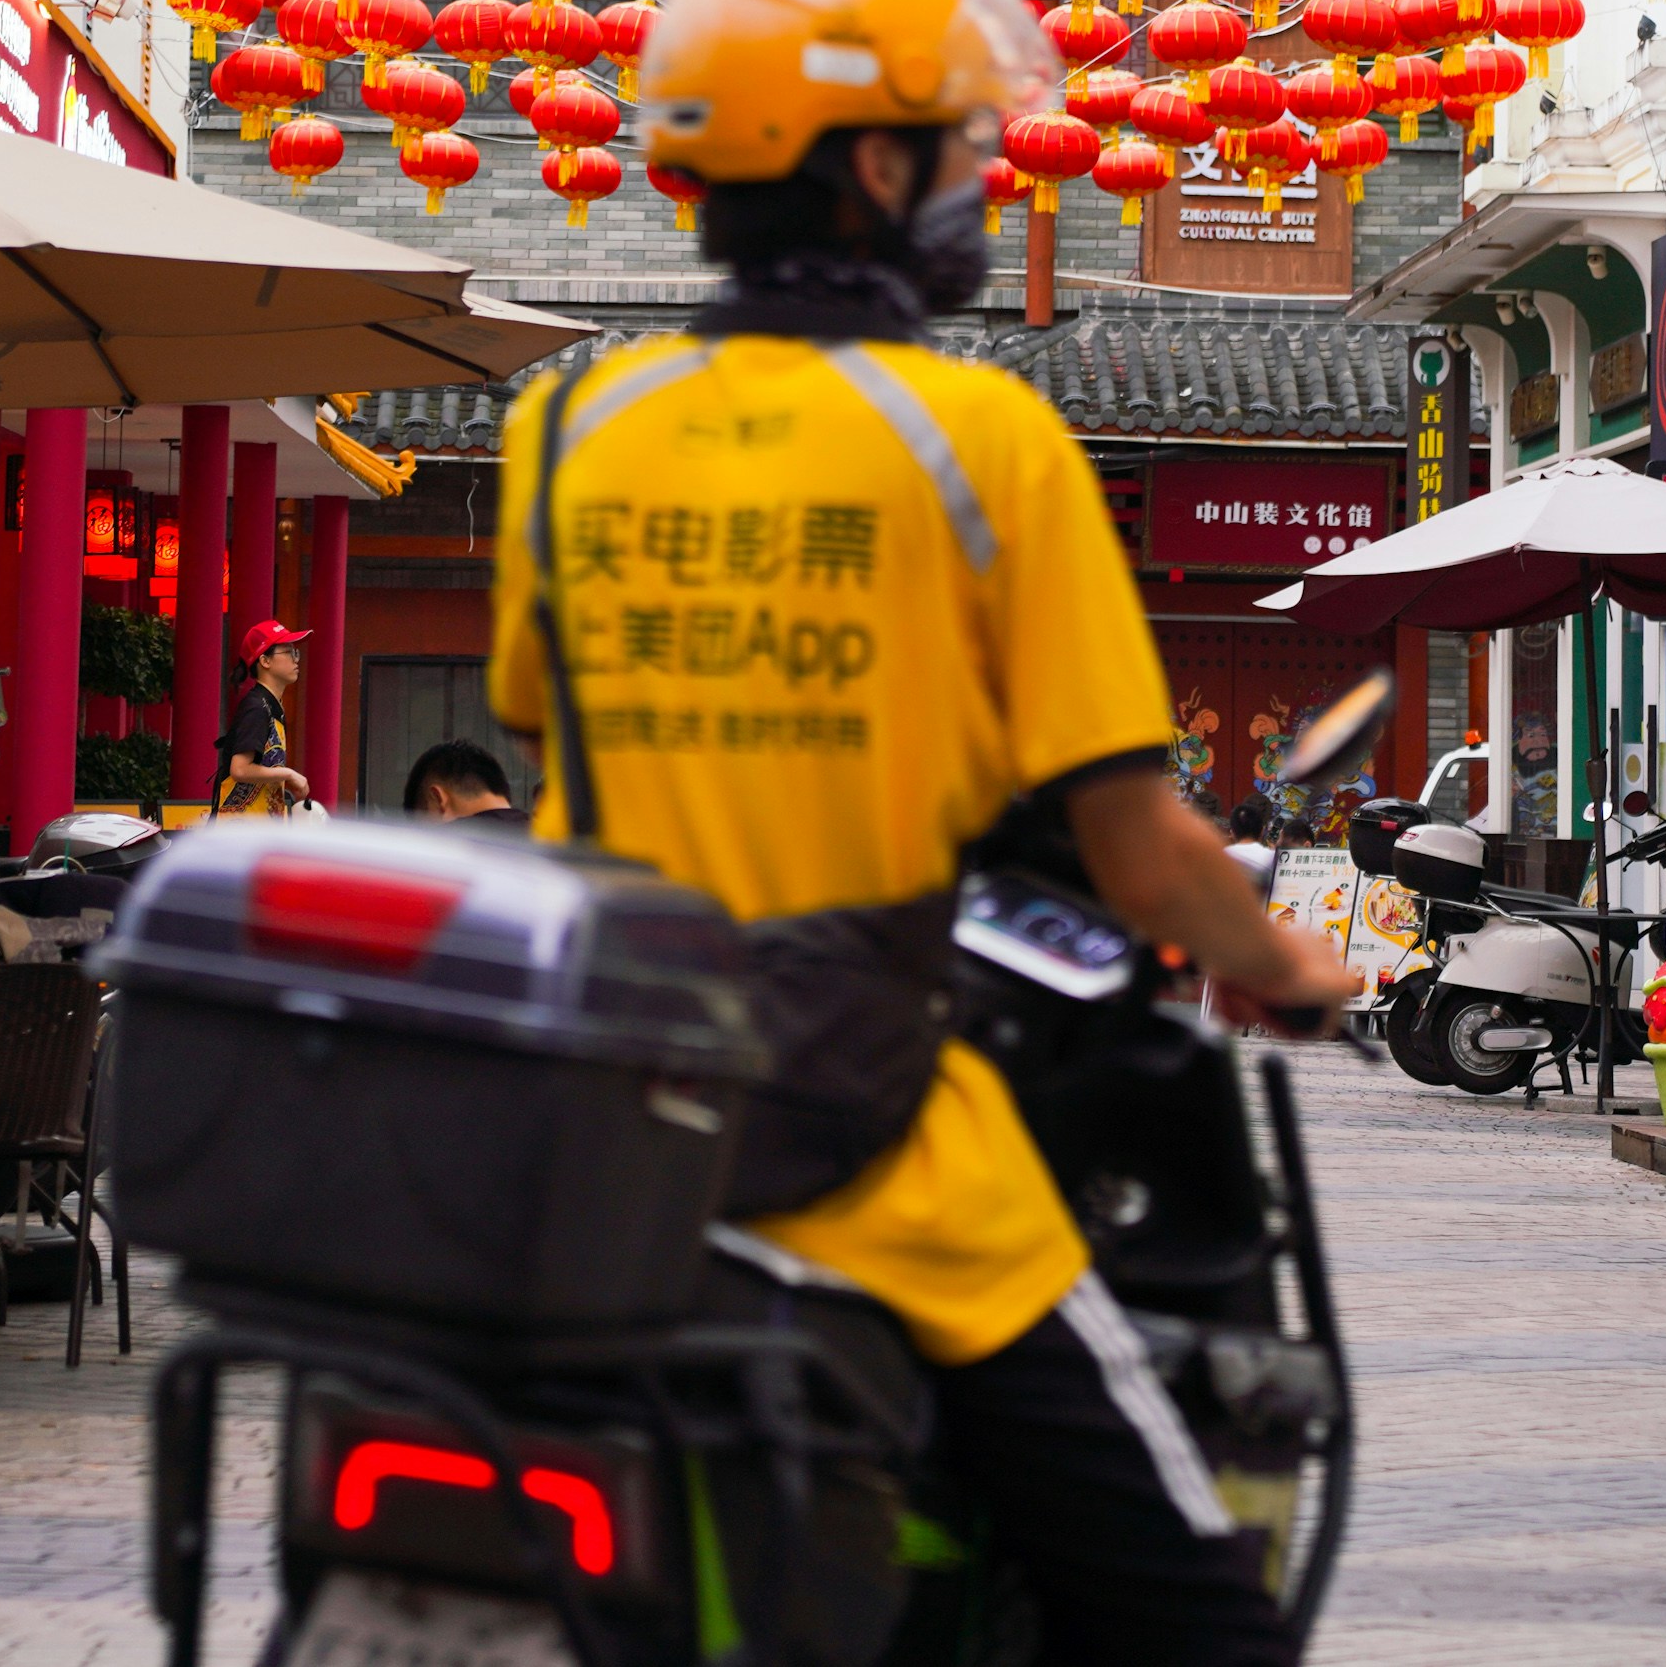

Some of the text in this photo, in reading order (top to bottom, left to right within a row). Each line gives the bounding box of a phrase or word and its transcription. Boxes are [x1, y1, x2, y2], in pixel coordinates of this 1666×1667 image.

[1281, 211, 1317, 225] SUIT
[1179, 227, 1315, 242] CULTURAL CENTER
[1196, 501, 1372, 528] 中山装文化馆
[568, 504, 879, 590] 买电影票
